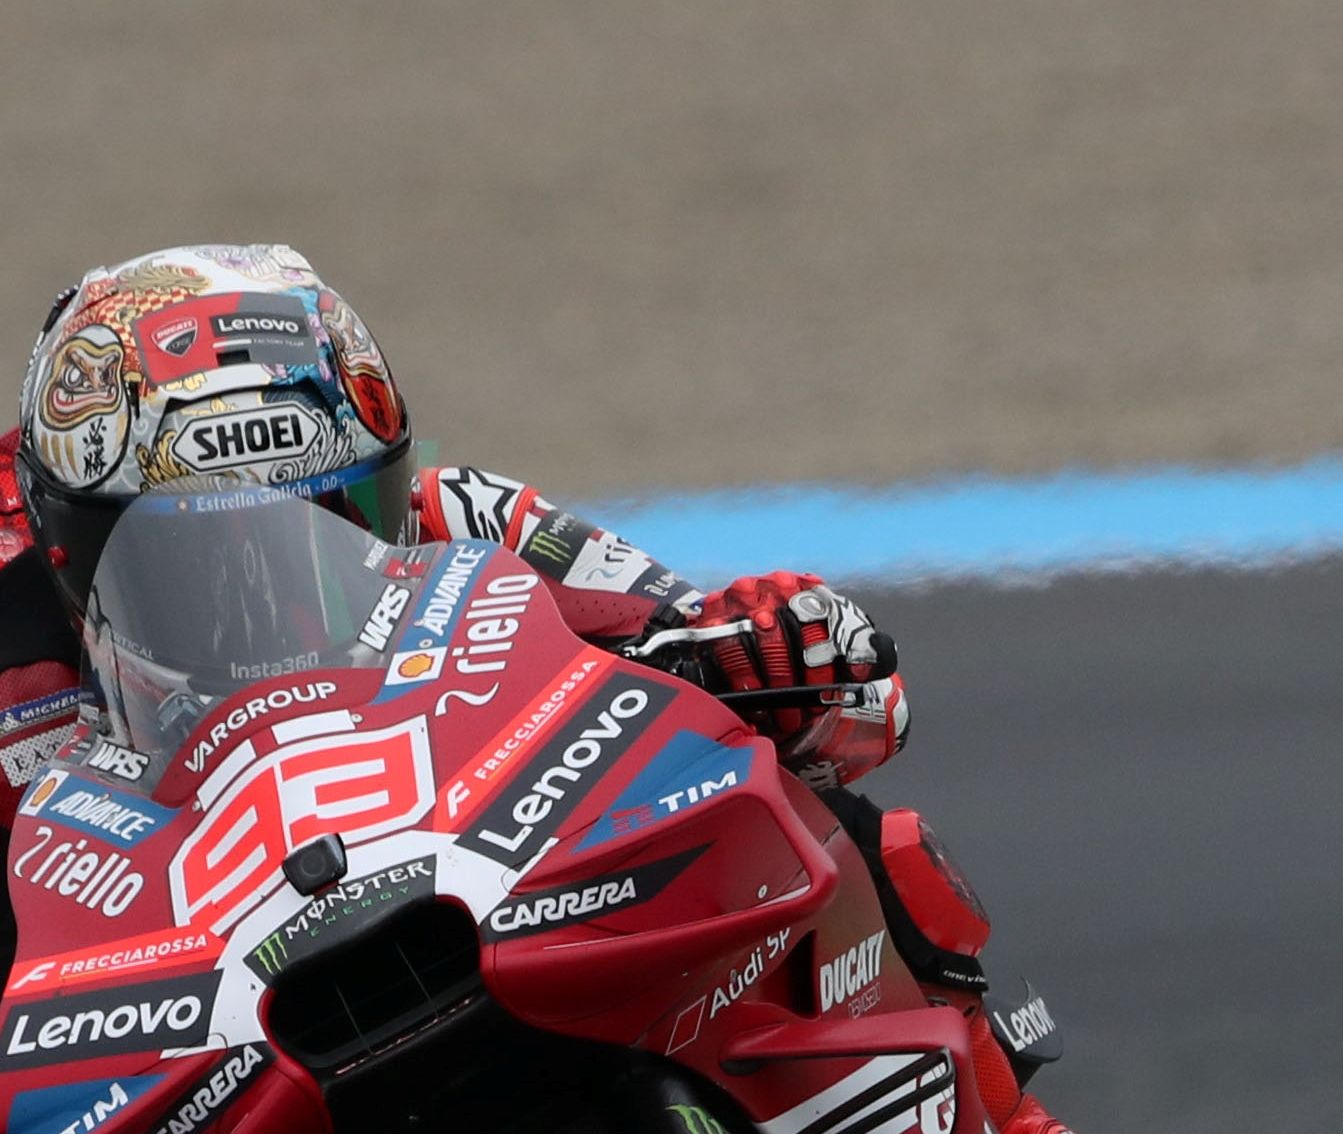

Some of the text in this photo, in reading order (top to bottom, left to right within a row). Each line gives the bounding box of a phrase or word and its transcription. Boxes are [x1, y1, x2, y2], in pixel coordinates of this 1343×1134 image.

[218, 317, 300, 334] Lenovo
[192, 414, 304, 461] SHOEI
[196, 492, 256, 513] Estrella
[257, 481, 313, 504] Galicia
[359, 583, 411, 652] WRS
[419, 543, 487, 637] ADVANCE
[453, 573, 540, 675] riello
[231, 651, 320, 690] Insta360
[184, 681, 337, 773] VARGROUP
[475, 659, 598, 780] FRECCIAROSSA
[89, 743, 150, 782] WRS
[479, 687, 649, 854] Lenovo
[658, 770, 737, 813] TIM
[50, 791, 155, 841] ADVANCE
[170, 715, 435, 930] 93
[30, 839, 144, 917] riello
[285, 861, 432, 940] MONSTER
[489, 876, 636, 934] CARRERA
[309, 886, 410, 938] ENERGY
[59, 933, 209, 977] FRECCIAROSSA
[819, 929, 886, 1013] DUCATI
[6, 994, 202, 1056] Lenovo
